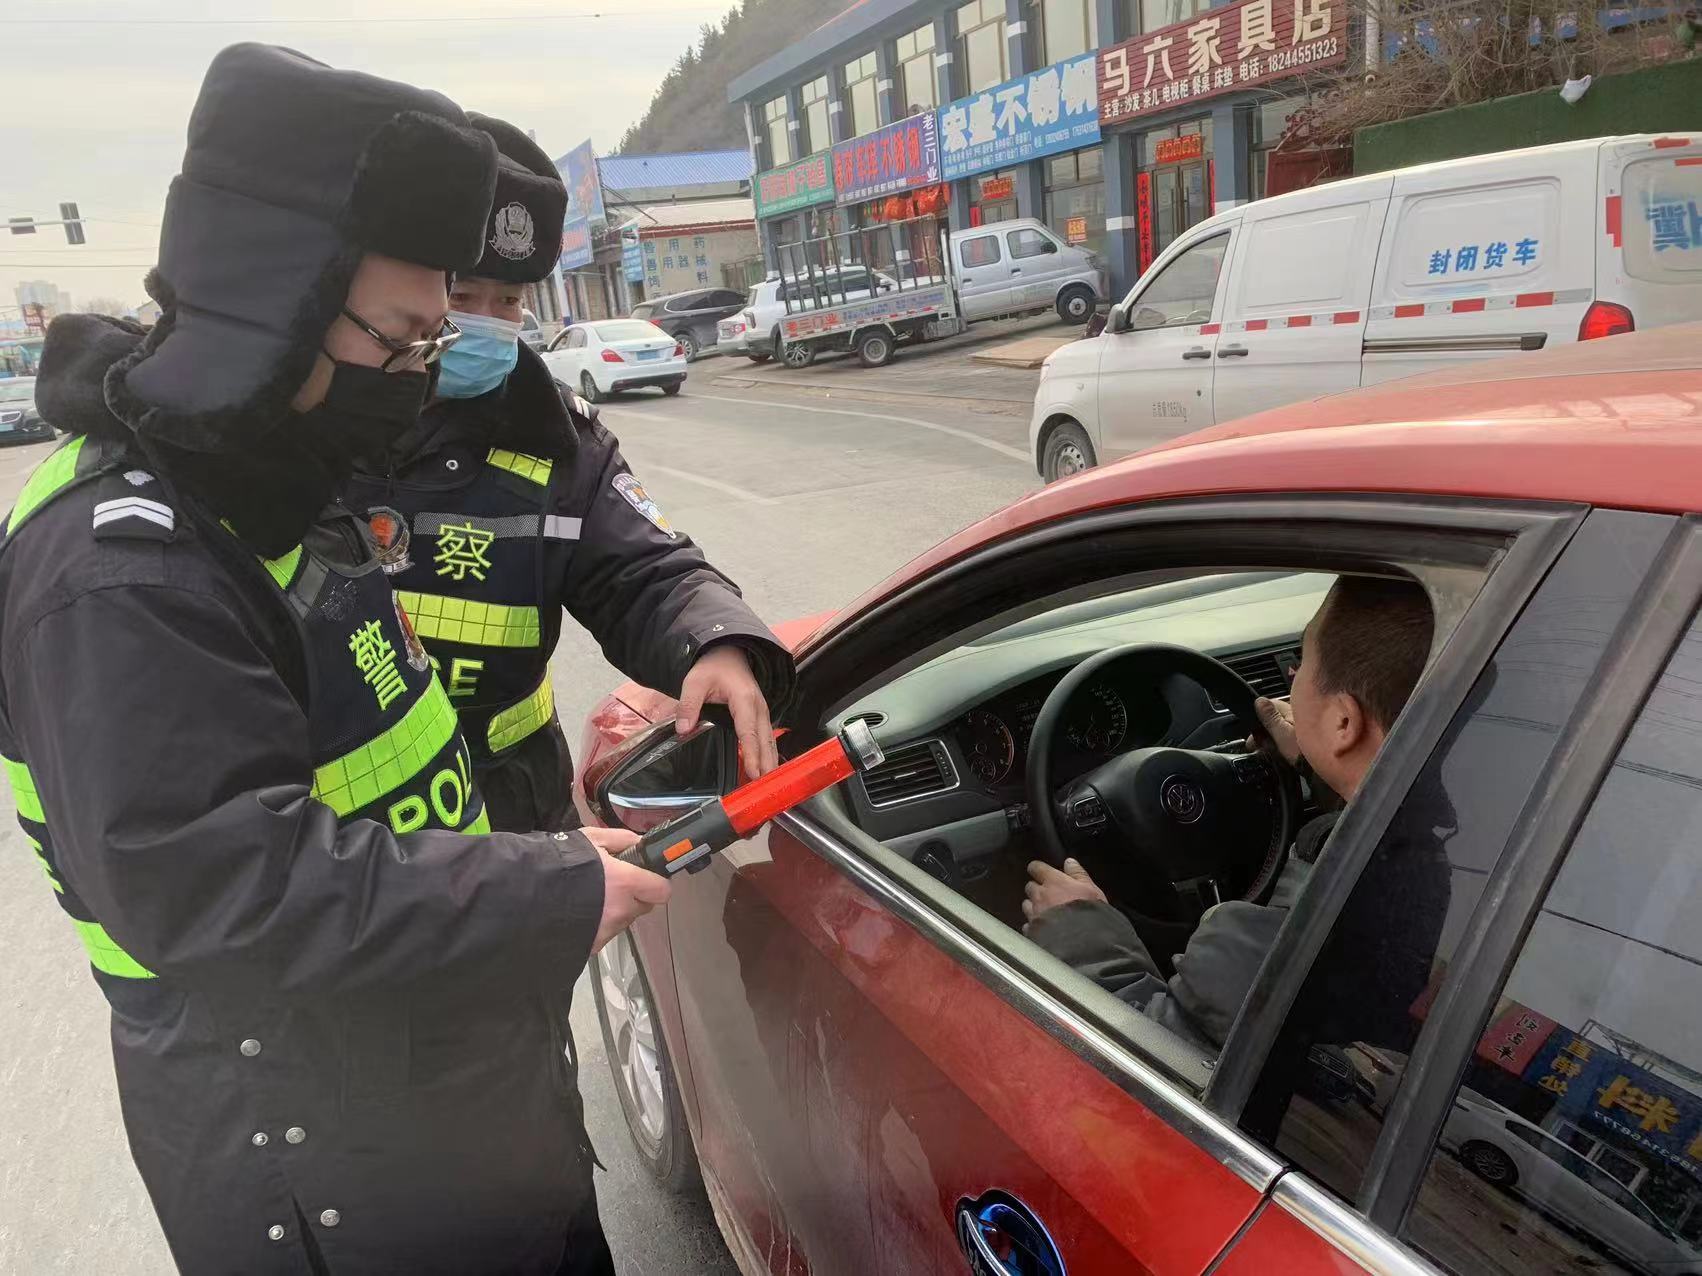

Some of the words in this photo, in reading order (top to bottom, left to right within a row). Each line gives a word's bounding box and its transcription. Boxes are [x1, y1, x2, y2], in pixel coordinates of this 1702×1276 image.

[1102, 0, 1332, 97] 马六家具店
[922, 113, 939, 183] 老三门业
[1428, 237, 1541, 276] 封闭货车
[433, 521, 496, 583] 察
[347, 618, 409, 711] 警
